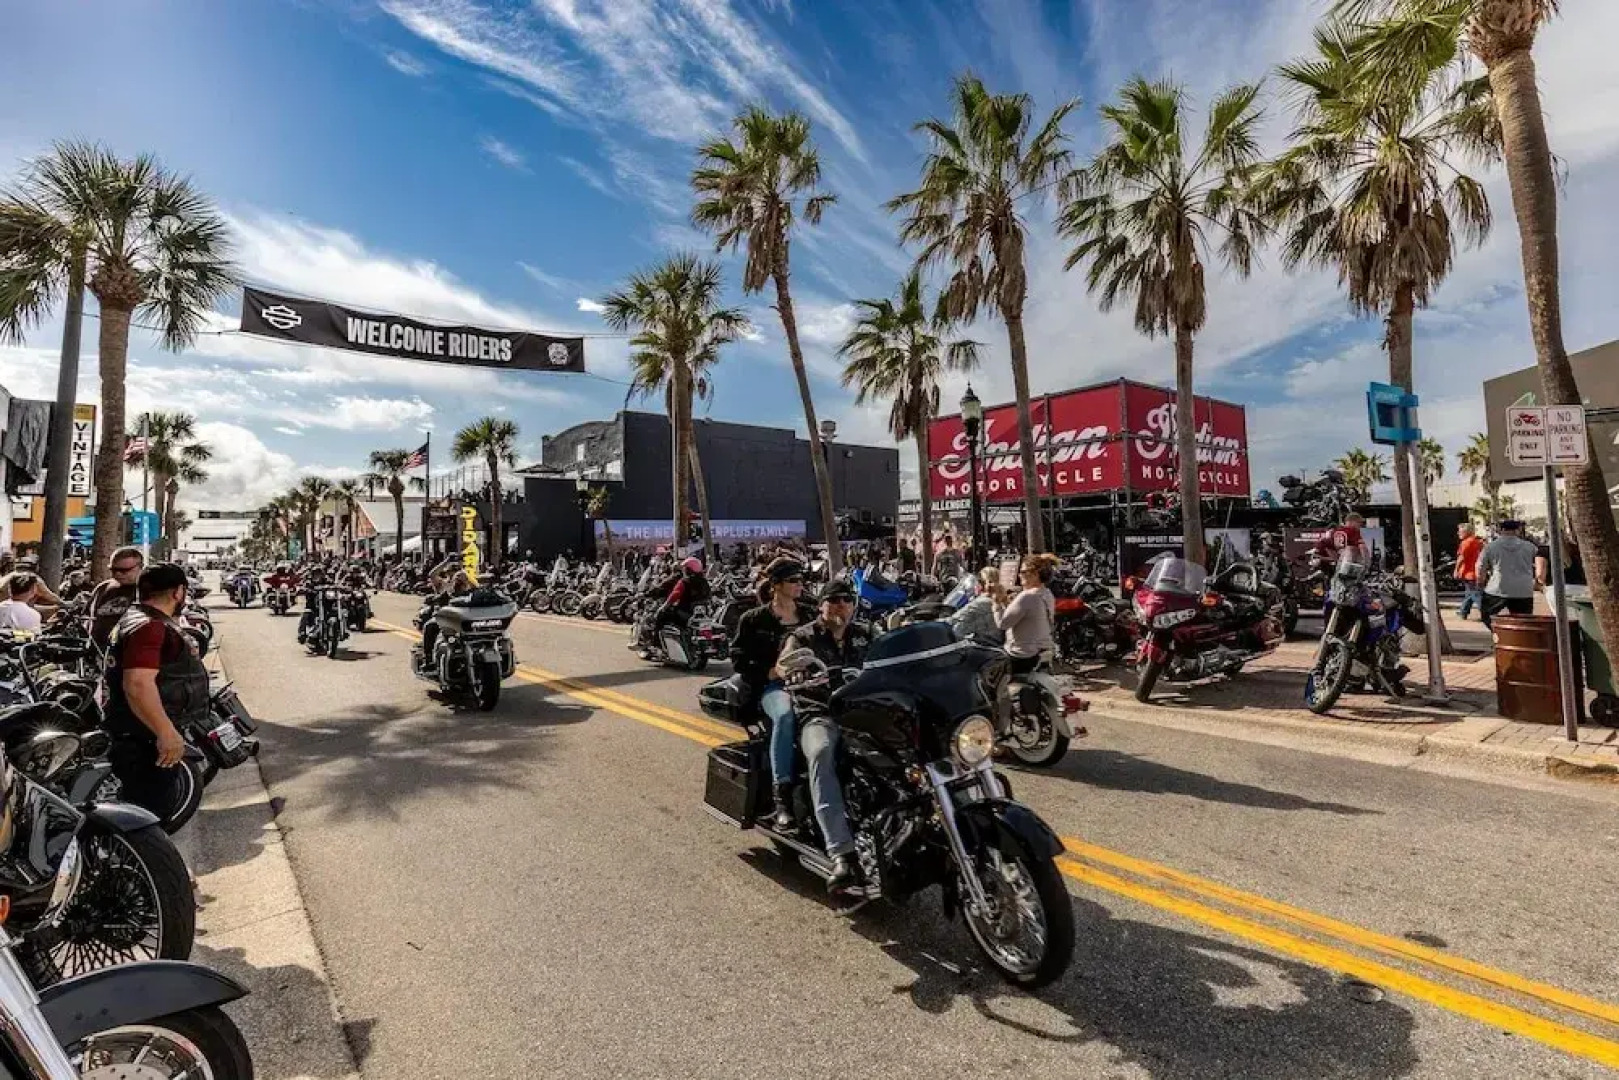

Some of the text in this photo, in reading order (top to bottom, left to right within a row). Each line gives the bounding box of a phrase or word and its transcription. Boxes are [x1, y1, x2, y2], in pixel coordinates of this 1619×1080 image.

[347, 317, 512, 361] WELCOME RIDERS
[1557, 411, 1571, 421] NO
[1511, 428, 1545, 436] PARKING
[1549, 424, 1581, 434] PARKING
[1520, 442, 1538, 450] ONLY
[71, 422, 87, 492] VINTAGE
[945, 467, 1103, 496] MOTORYCLE
[1142, 465, 1239, 486] MOTCYCLE
[627, 525, 789, 539] THE NE ERPLUS FAMILY
